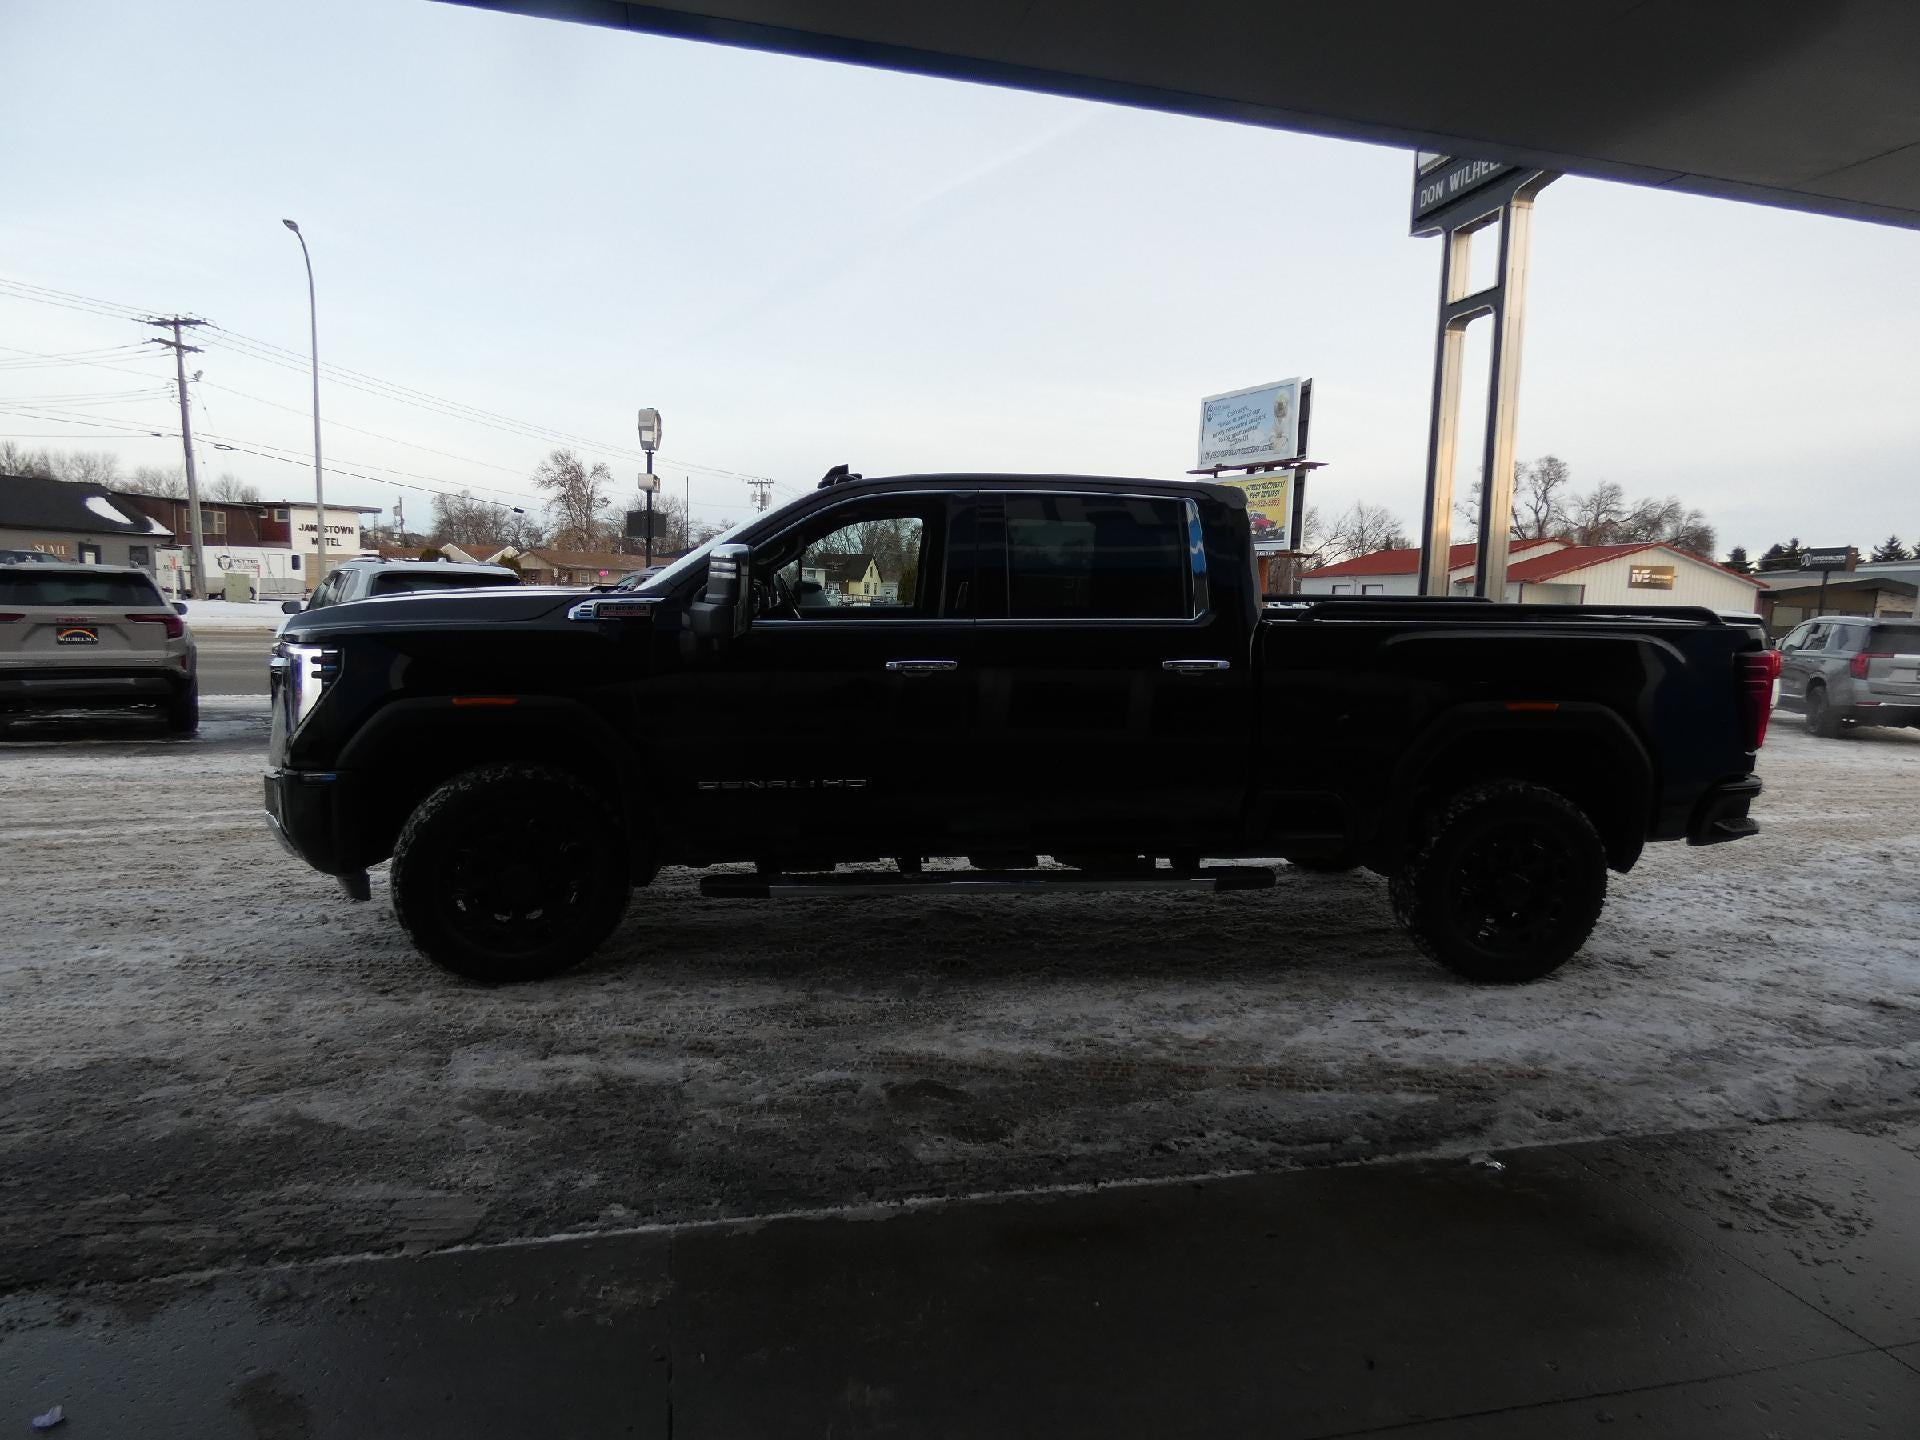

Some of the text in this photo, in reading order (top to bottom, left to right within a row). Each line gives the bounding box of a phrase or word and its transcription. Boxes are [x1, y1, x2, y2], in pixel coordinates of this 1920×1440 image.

[1420, 161, 1500, 208] DON WILHEL
[298, 523, 354, 534] JAMSTOWN
[311, 537, 342, 546] MTEL
[697, 778, 816, 791] DENALI
